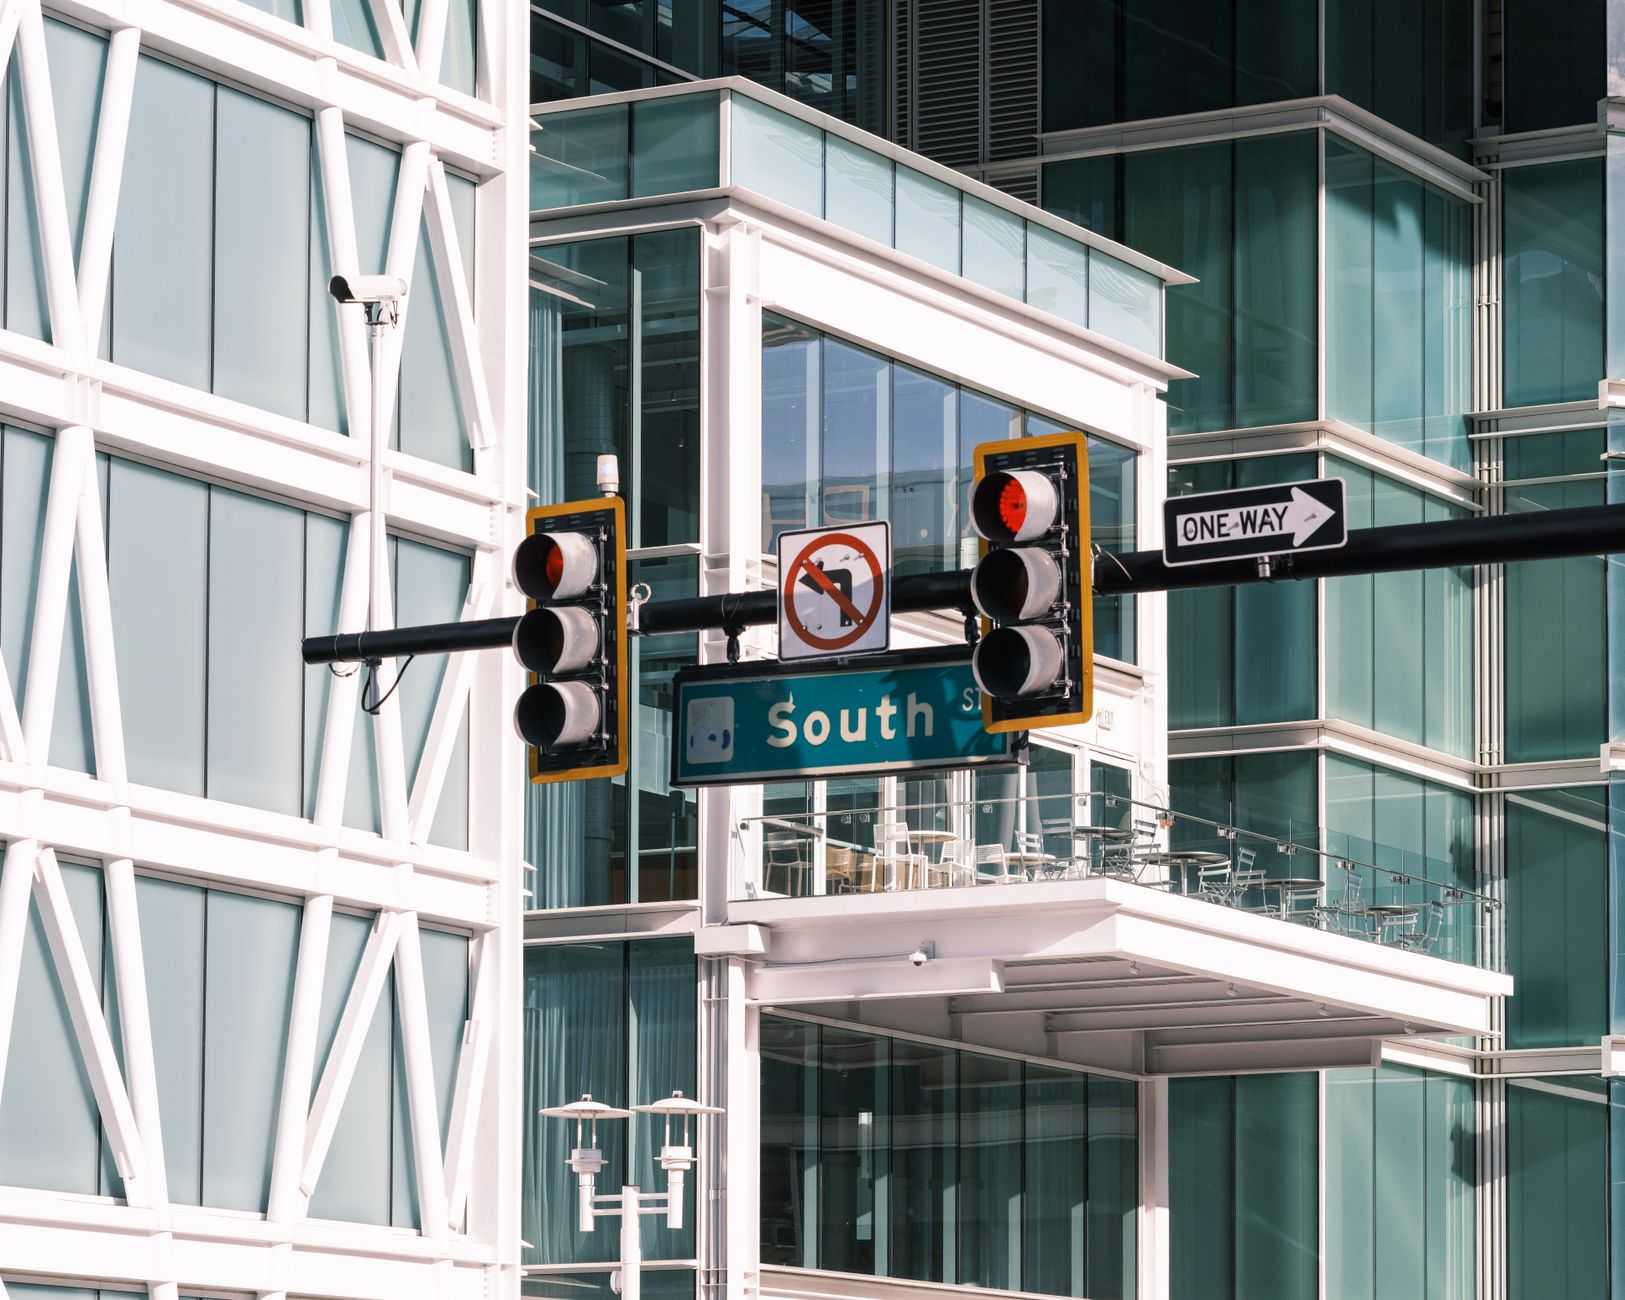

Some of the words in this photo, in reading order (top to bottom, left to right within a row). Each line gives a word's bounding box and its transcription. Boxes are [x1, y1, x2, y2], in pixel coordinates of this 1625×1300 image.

[1183, 514, 1230, 541] ONE
[1239, 505, 1288, 534] WAY
[766, 691, 933, 748] South
